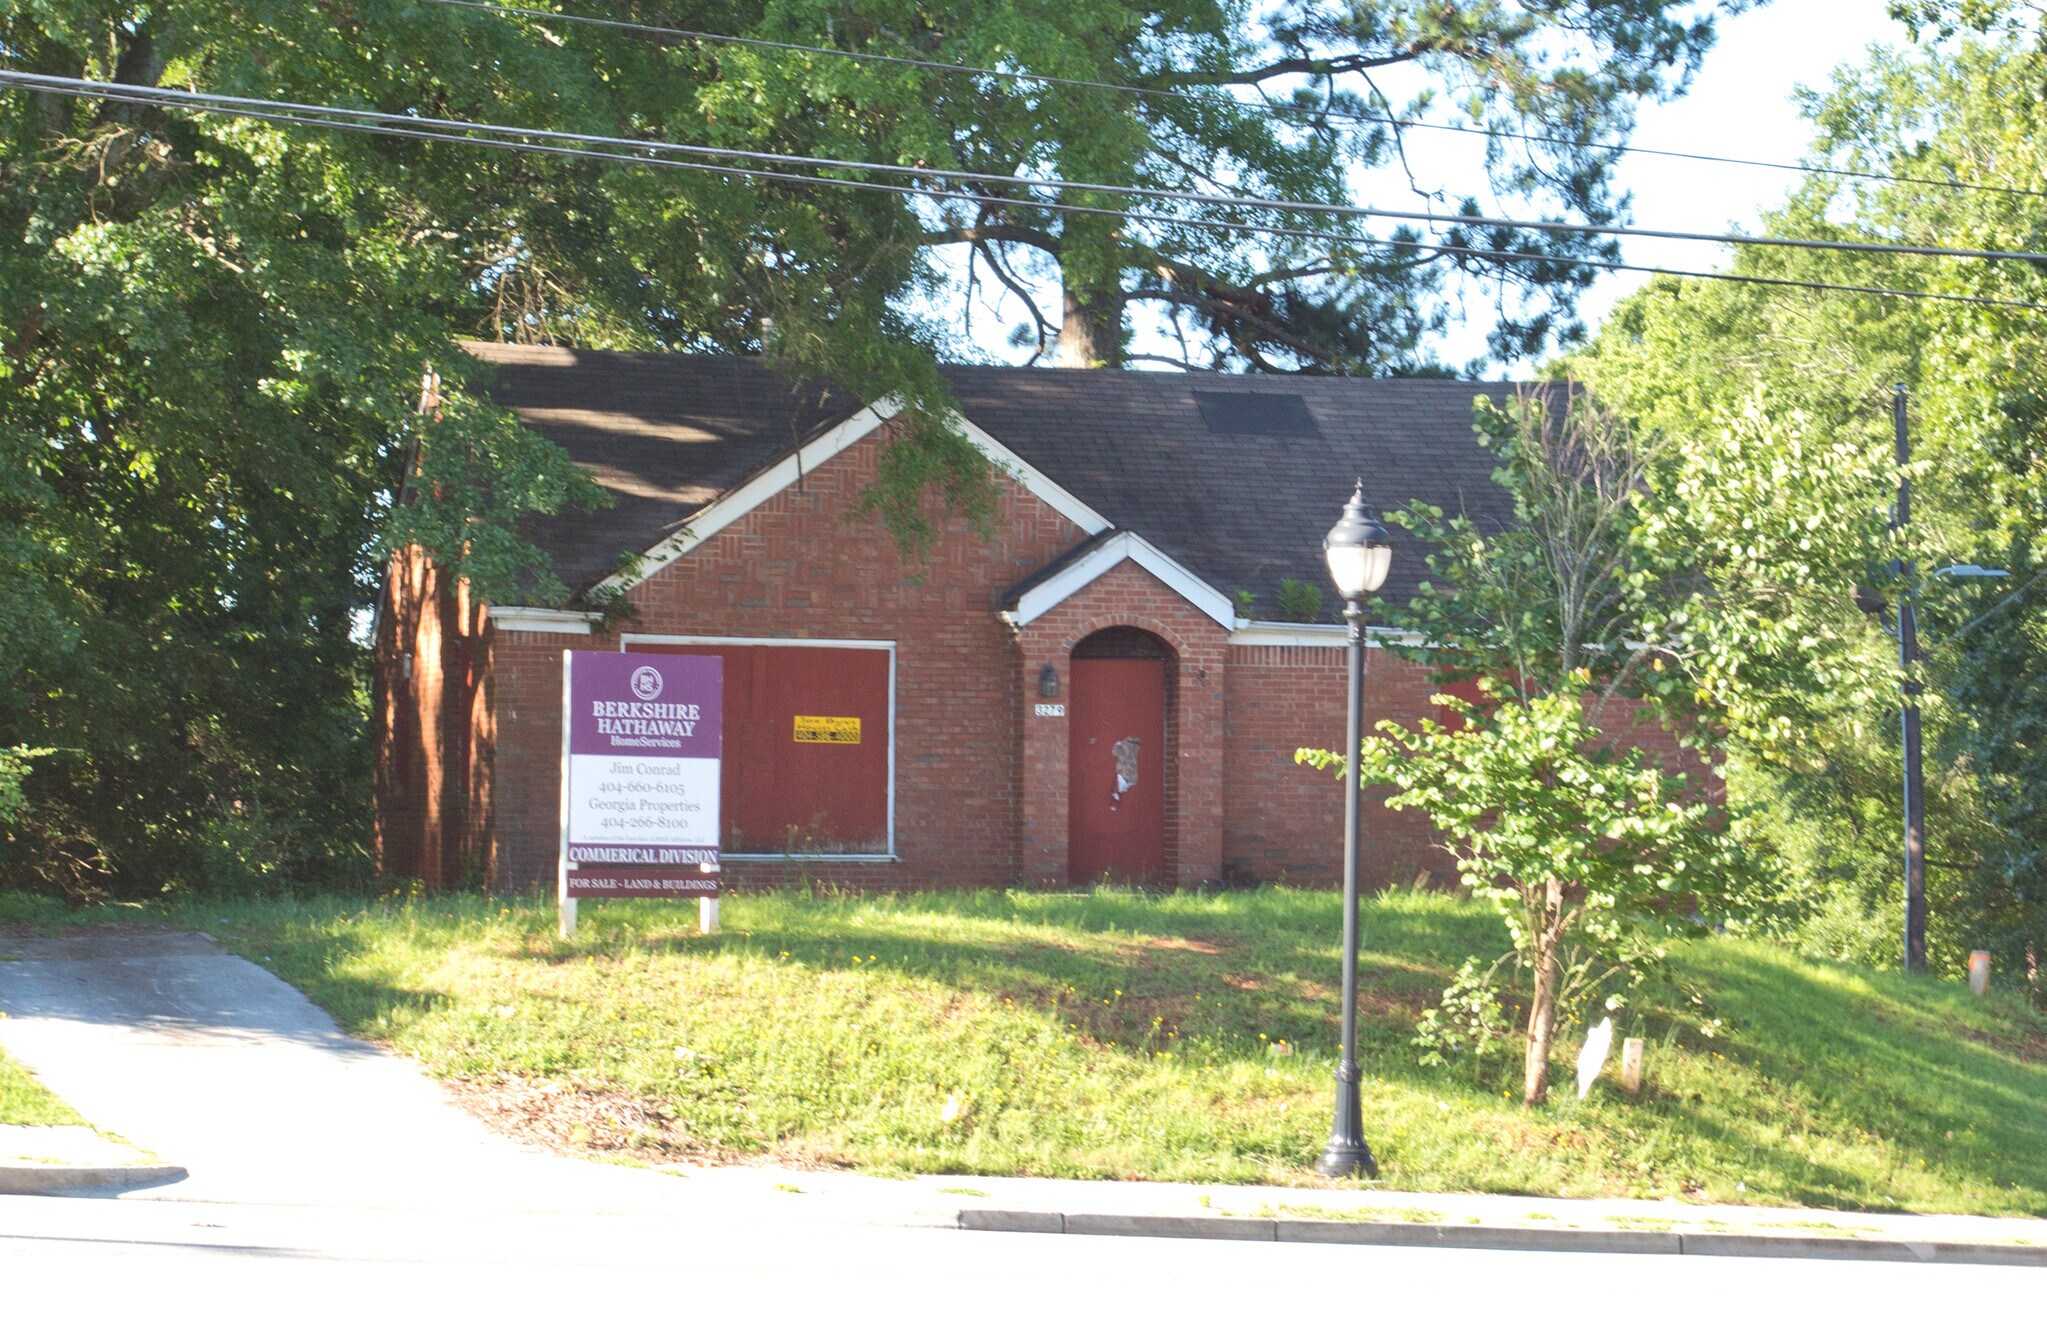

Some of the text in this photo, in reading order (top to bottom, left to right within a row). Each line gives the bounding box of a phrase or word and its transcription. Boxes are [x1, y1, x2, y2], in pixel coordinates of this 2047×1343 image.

[592, 701, 701, 720] BERKSHIRE
[597, 718, 696, 737] HATHAWAY
[610, 735, 682, 748] HomeServices
[609, 762, 681, 776] Jim Conrad
[598, 781, 686, 796] 404-660-6105
[588, 797, 701, 814] Georgia Properties
[600, 816, 688, 829] 404-266-8100
[569, 847, 718, 864] COMMERICAL DIVISION
[569, 878, 591, 889] FOR
[591, 878, 617, 889] SALE
[624, 879, 652, 889] LAND
[653, 879, 662, 889] &
[662, 879, 718, 890] BUILDINGS
